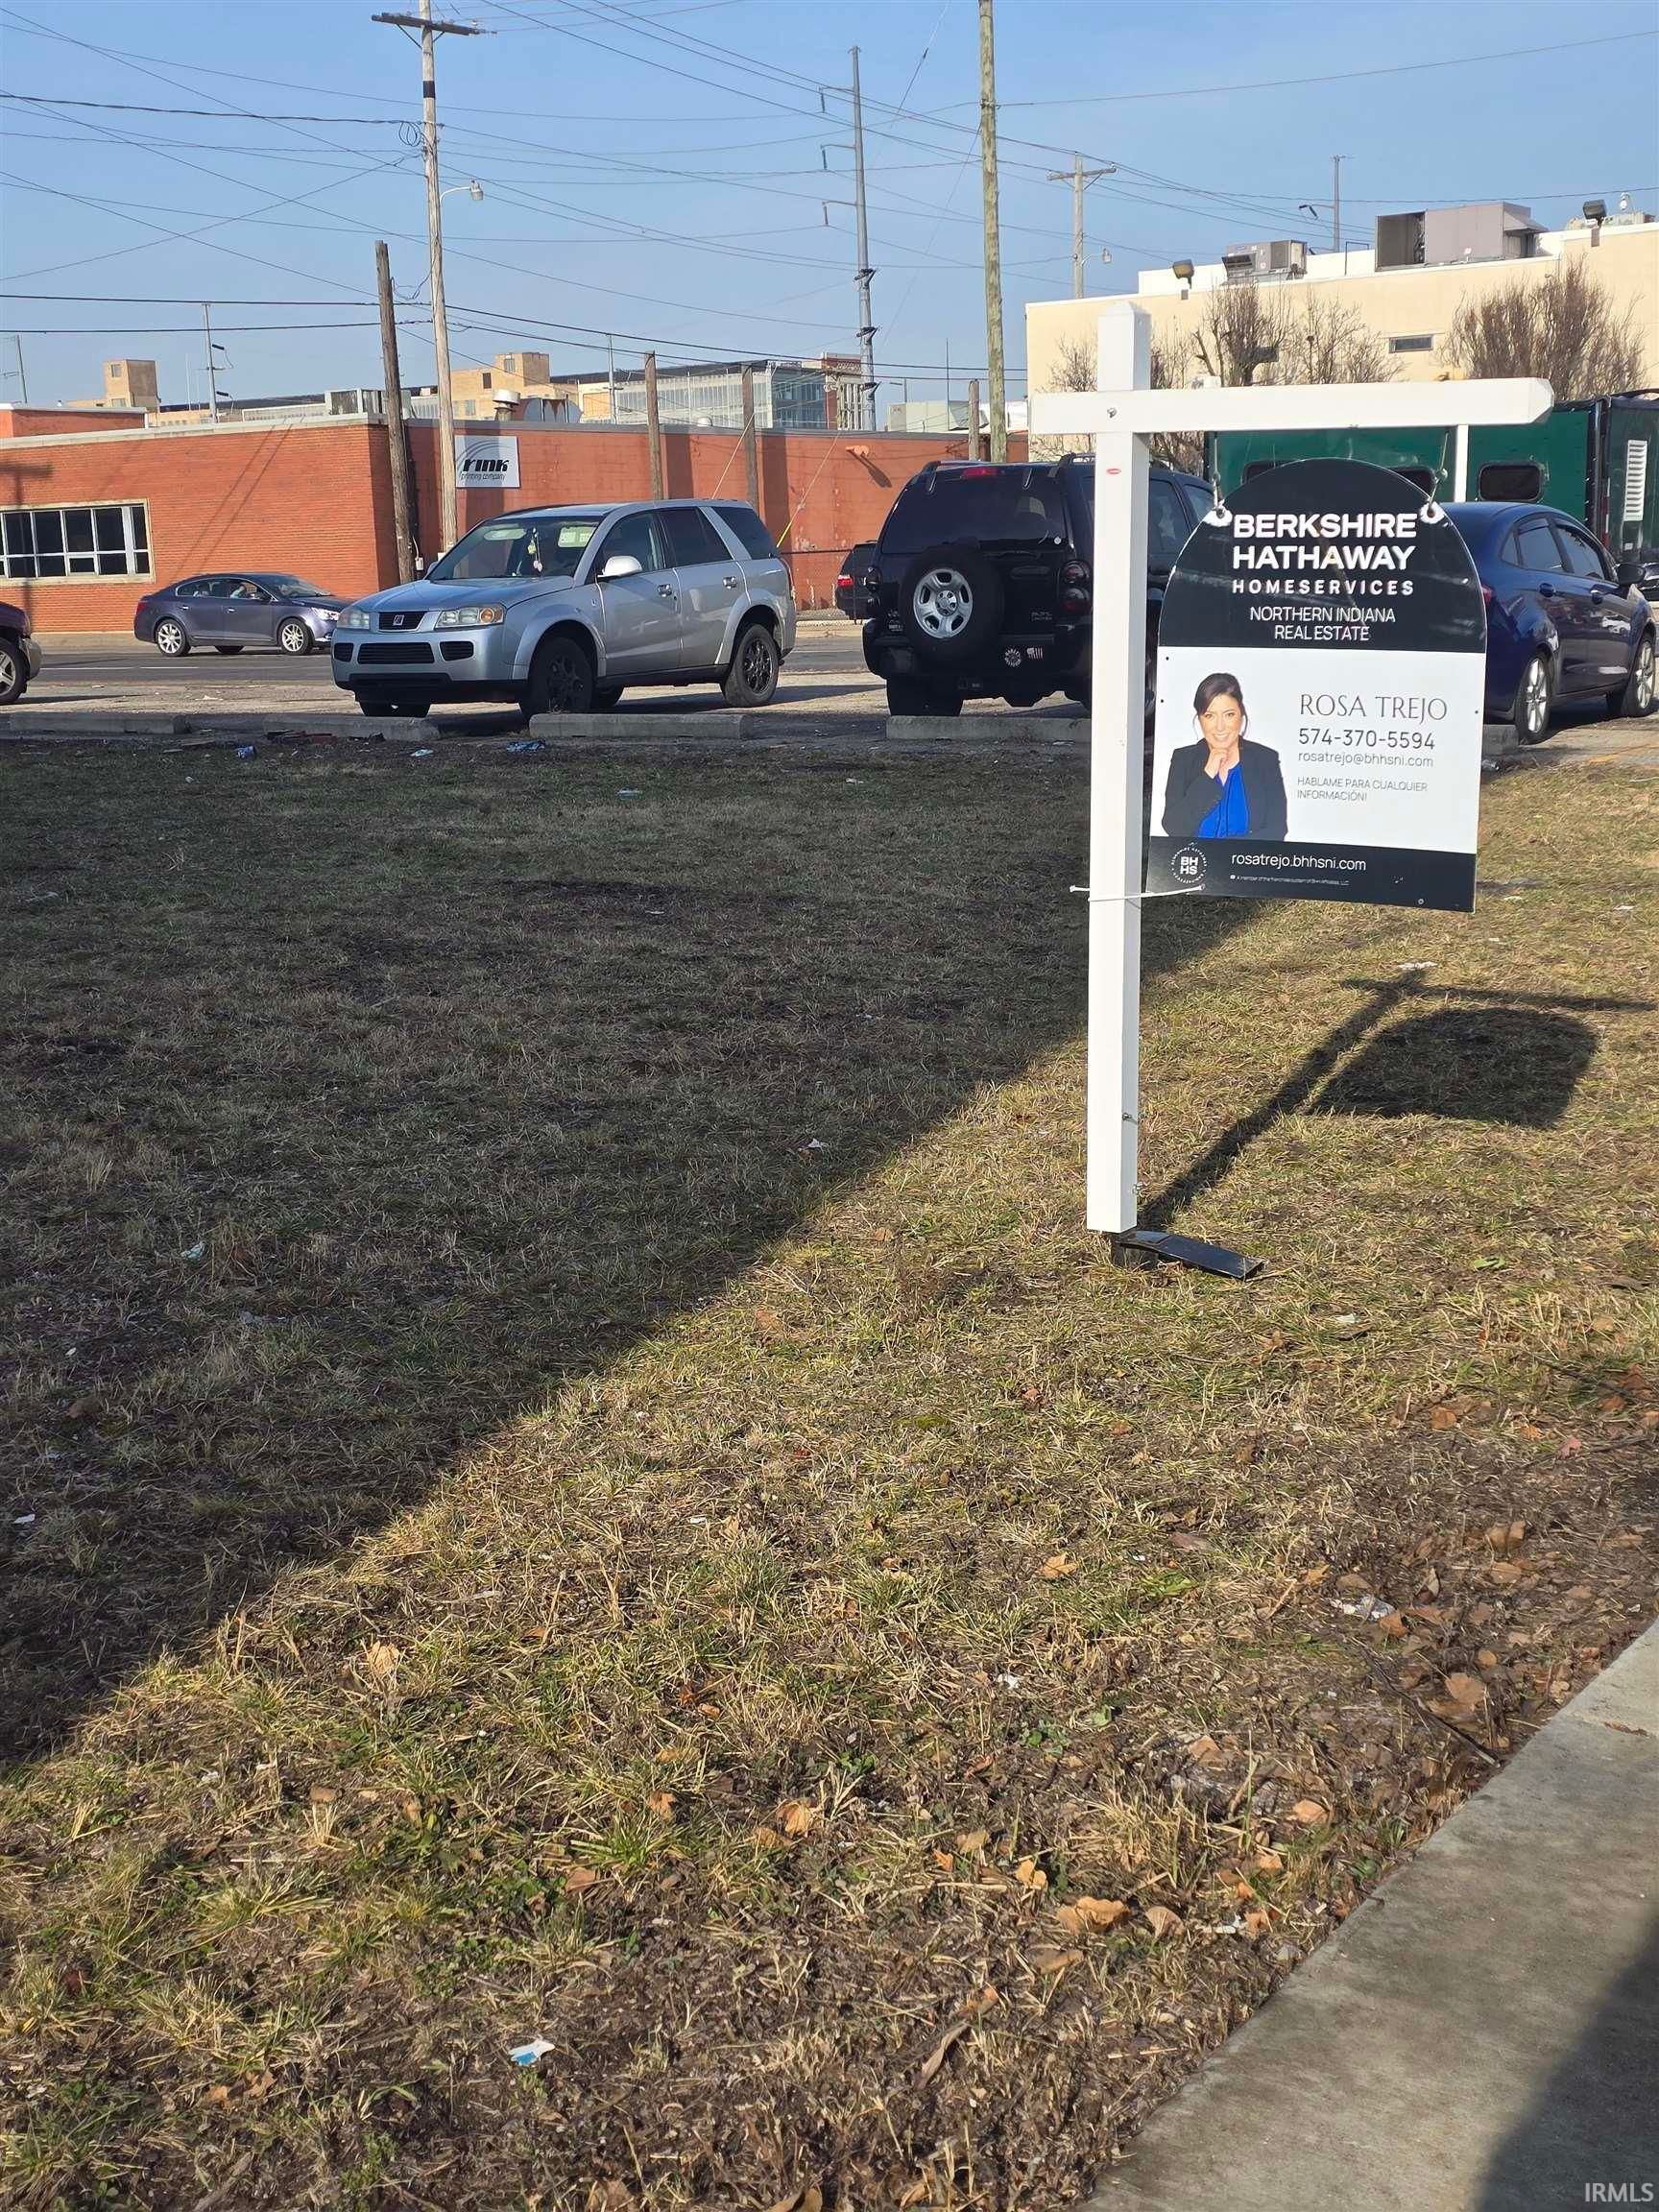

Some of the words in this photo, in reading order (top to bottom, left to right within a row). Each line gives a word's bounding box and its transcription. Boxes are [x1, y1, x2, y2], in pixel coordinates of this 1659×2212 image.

[1233, 513, 1418, 539] BERKSHIRE
[1233, 545, 1416, 570] HATHAWAY
[1232, 579, 1414, 595] HOMESERVICES
[1250, 606, 1333, 622] NORTHERN
[1335, 607, 1396, 623] INDIANA
[1300, 694, 1367, 717] ROSA
[1375, 696, 1448, 725] TREJO
[1298, 728, 1435, 750] 574-370-5594
[1298, 752, 1433, 767] rosatrejo@bhhsni.com
[1345, 778, 1371, 789] PARA
[1181, 856, 1199, 866] BH
[1231, 854, 1367, 871] rosatrejo.bhhsni.com
[1180, 865, 1198, 876] HS
